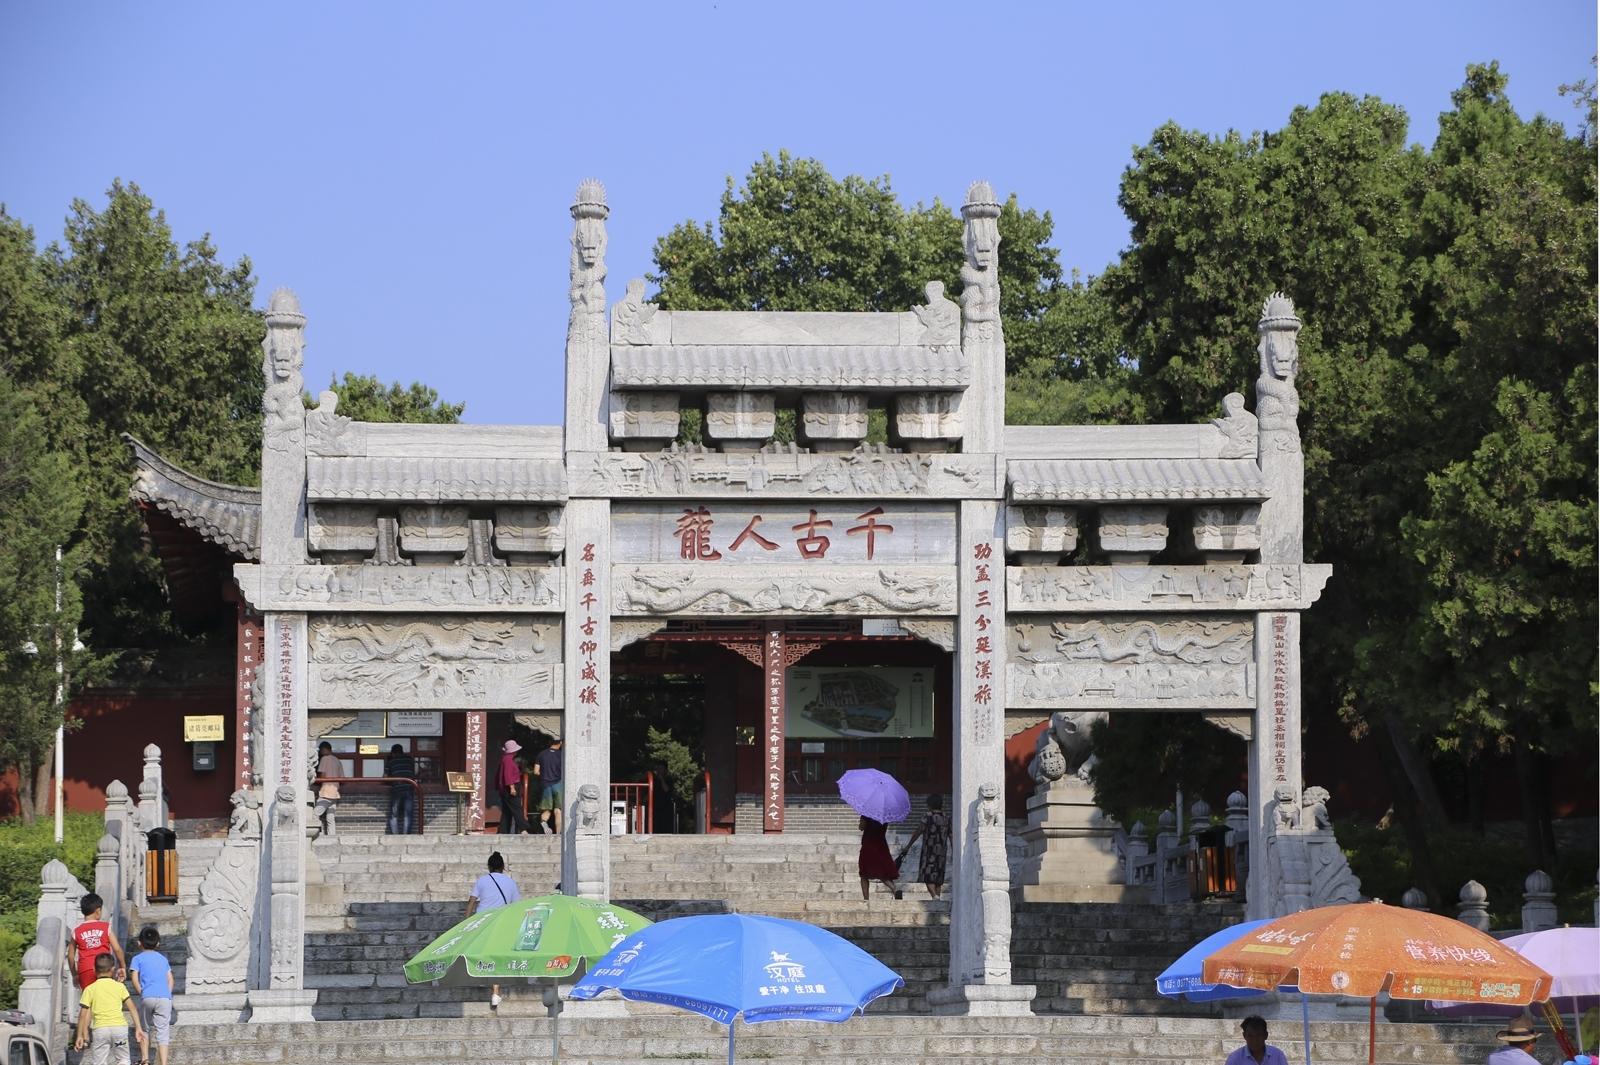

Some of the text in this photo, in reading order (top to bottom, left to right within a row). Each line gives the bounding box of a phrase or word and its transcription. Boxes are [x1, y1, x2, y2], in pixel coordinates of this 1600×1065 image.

[673, 506, 894, 561] 千古人龍
[1403, 943, 1497, 964] 营养快线
[766, 966, 807, 979] 汉庭
[758, 984, 828, 996] 爱干净 住汉庭
